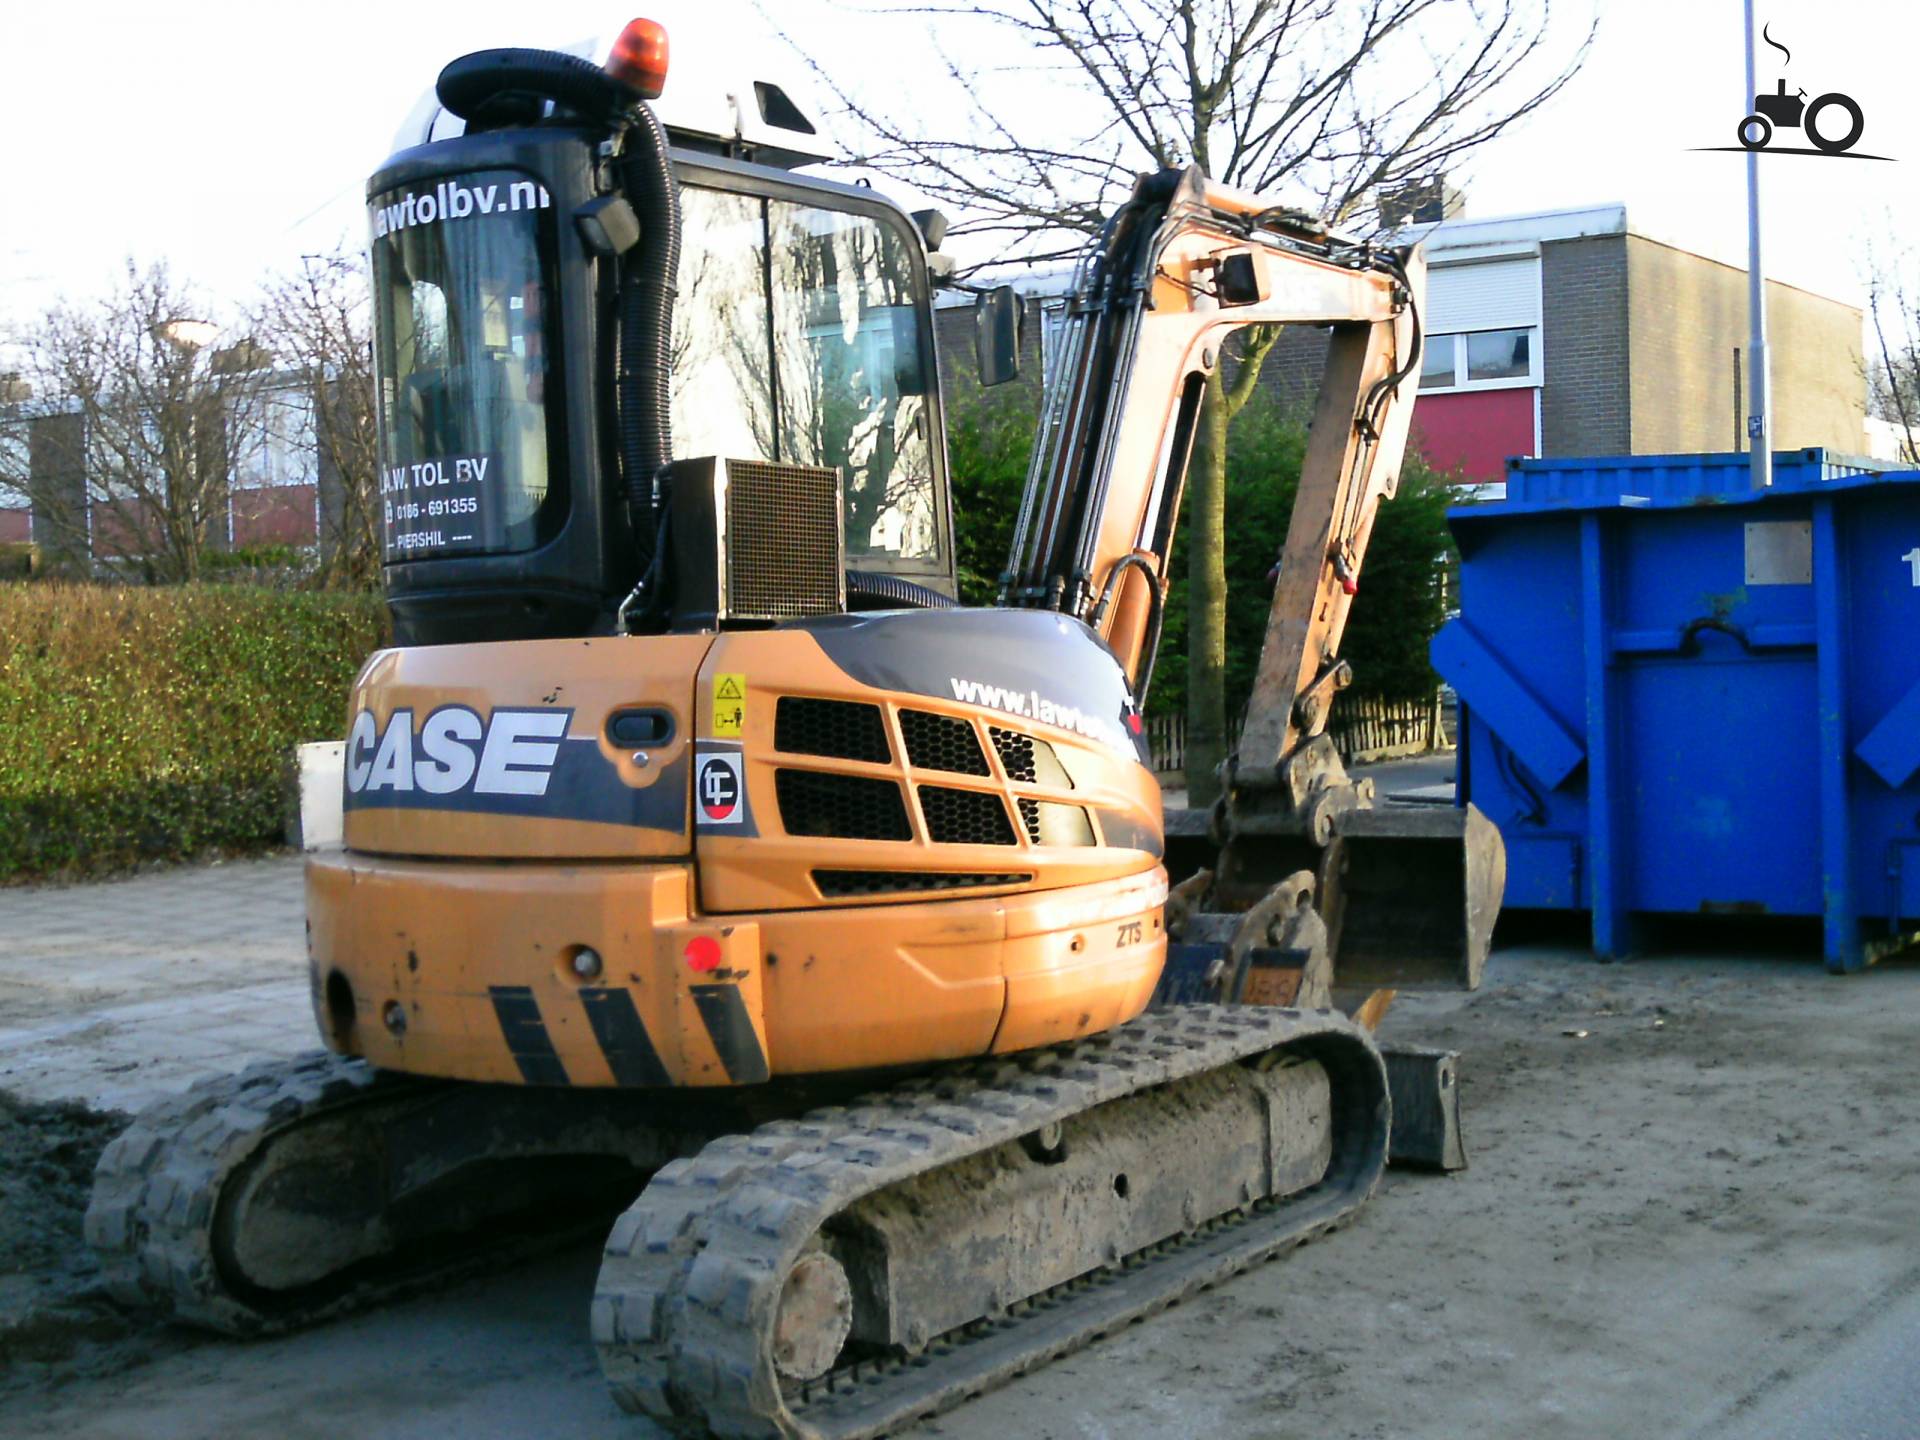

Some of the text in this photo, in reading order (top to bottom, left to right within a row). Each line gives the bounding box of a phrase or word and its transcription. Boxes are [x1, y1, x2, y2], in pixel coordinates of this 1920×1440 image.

[411, 461, 450, 488] TOL
[455, 457, 489, 483] BV
[428, 497, 478, 517] 691355
[397, 530, 446, 550] PIERSHIL
[346, 707, 570, 796] CASE
[1116, 921, 1142, 949] ZTS
